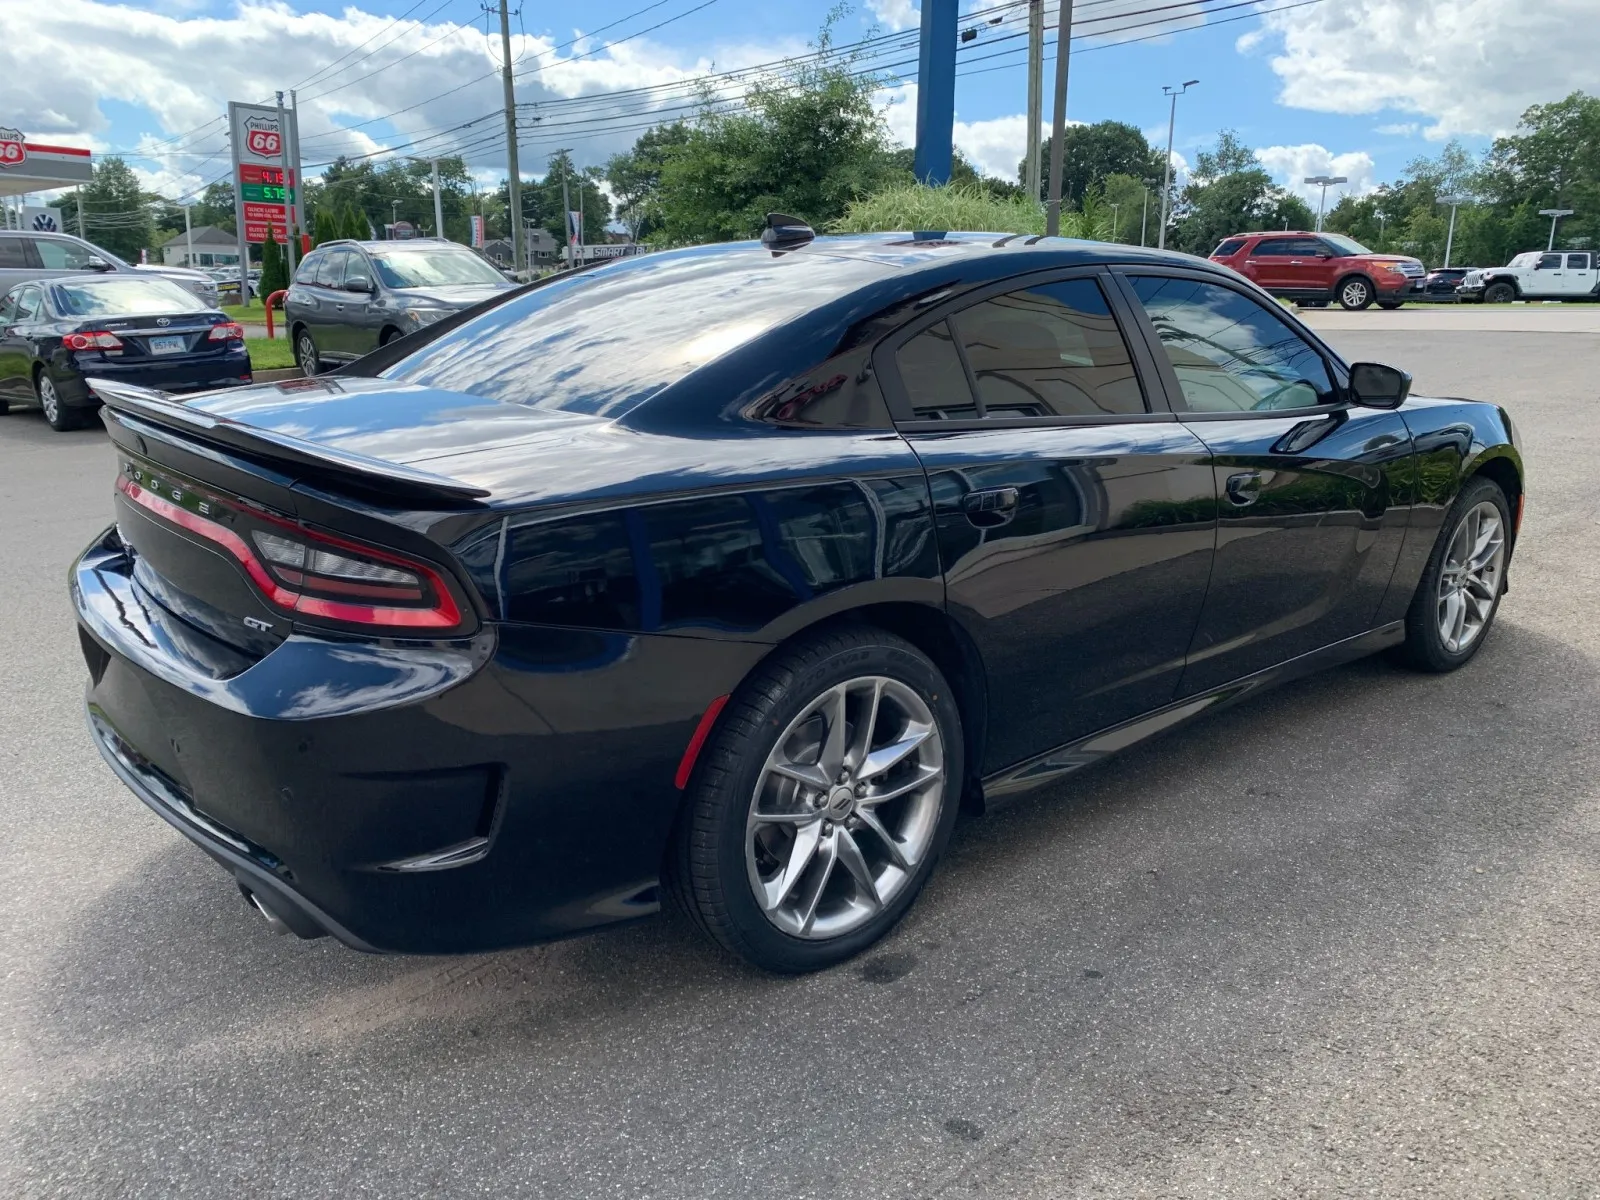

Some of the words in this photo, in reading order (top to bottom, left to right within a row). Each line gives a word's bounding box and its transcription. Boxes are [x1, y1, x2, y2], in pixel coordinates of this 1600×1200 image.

[250, 121, 279, 132] PHILLIPS
[253, 133, 278, 150] 66
[594, 247, 625, 257] SMART
[124, 462, 210, 515] DODGE
[243, 616, 274, 632] GT
